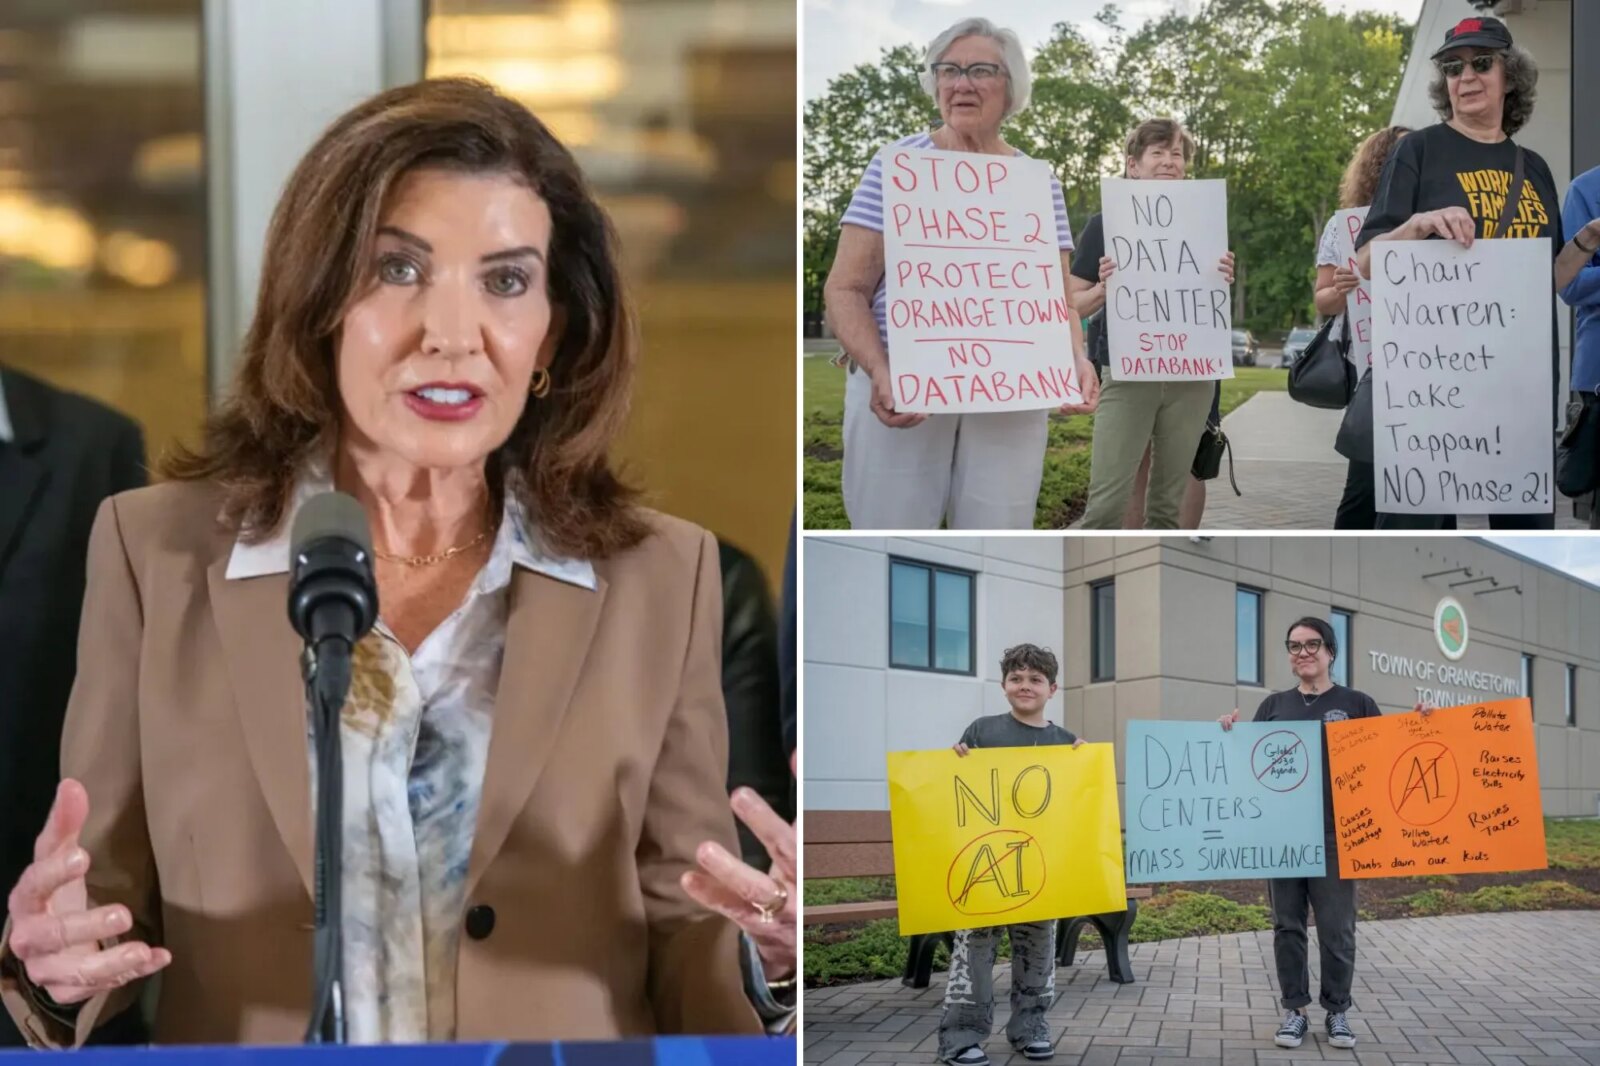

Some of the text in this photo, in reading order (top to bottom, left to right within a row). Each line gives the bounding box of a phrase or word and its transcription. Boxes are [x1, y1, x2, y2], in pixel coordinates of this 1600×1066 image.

[891, 152, 1008, 195] STOP
[893, 203, 1049, 245] PHASE 2
[1131, 194, 1173, 228] NO
[1112, 236, 1200, 275] DATA
[1384, 249, 1481, 285] Chair
[897, 260, 1054, 290] PROTECT
[891, 297, 1070, 329] ORANGETOWN
[1115, 285, 1228, 330] CENTER
[1383, 293, 1516, 328] Warren:
[948, 343, 992, 368] NO
[1139, 332, 1188, 352] STOP
[1382, 341, 1496, 372] Protect
[1121, 356, 1225, 376] DATABANK!
[898, 366, 1083, 406] DATABANK
[1385, 381, 1466, 410] Lake
[1384, 423, 1502, 462] Tappan!
[1383, 464, 1550, 506] NO Phase 2!
[1368, 650, 1521, 696] TOWN OF ORANGETOWN
[1144, 734, 1229, 790] DATA
[1472, 767, 1525, 781] Electricity
[1480, 750, 1522, 764] Raises
[954, 764, 1051, 828] NO
[1402, 756, 1447, 804] AI
[1138, 793, 1262, 832] CENTERS
[1468, 803, 1510, 828] Raises
[958, 840, 1030, 907] AI
[1129, 844, 1323, 878] MASS SURVEILLANCE
[1390, 857, 1416, 868] down
